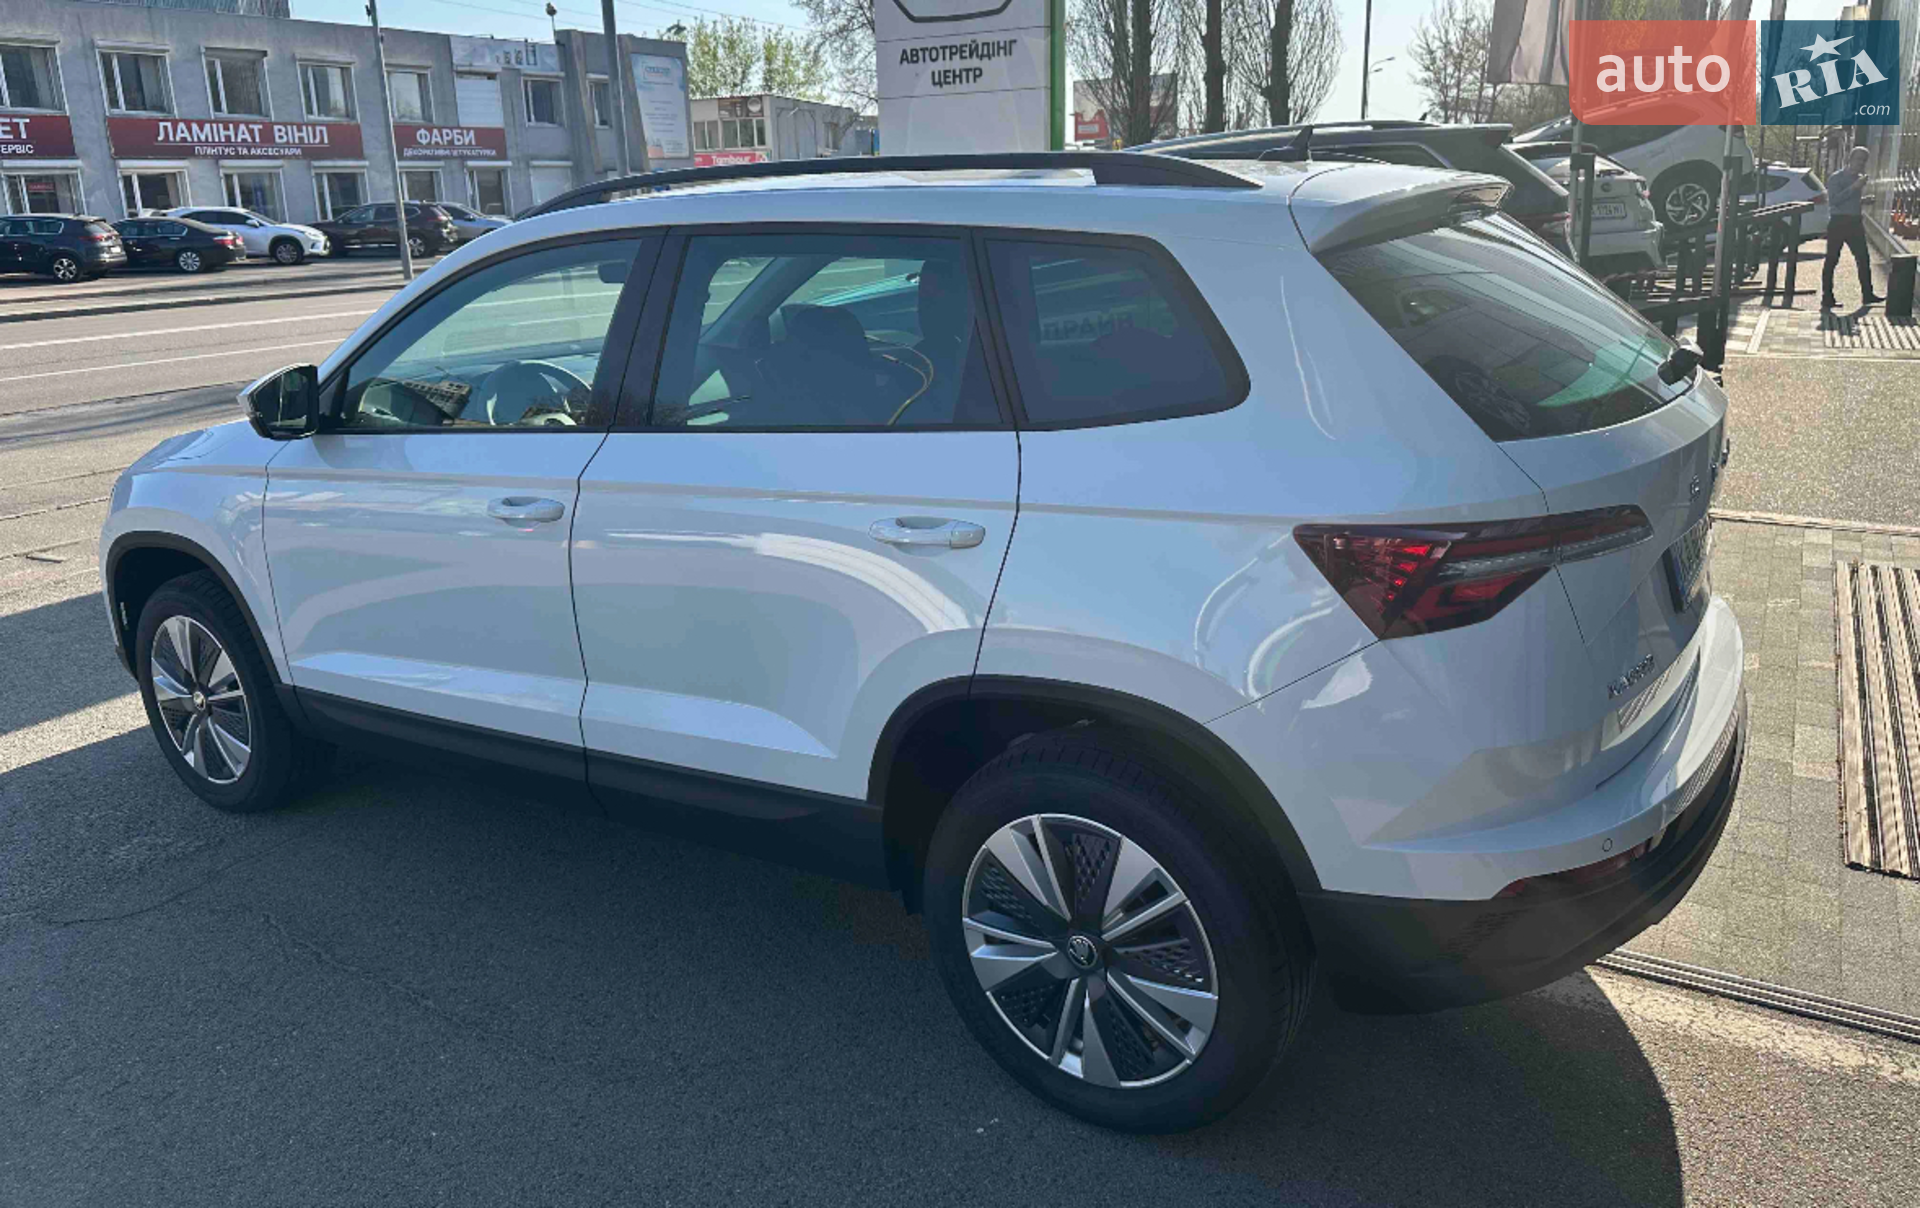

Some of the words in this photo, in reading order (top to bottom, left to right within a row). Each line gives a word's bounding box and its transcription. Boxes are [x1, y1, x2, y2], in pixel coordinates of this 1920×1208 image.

[900, 39, 1018, 65] АВТОТРЕЙДІНГ
[931, 67, 983, 88] ЦЕНТР
[157, 121, 263, 143] ЛАМІНАТ
[273, 124, 329, 144] ВІНІЛ
[416, 128, 476, 146] ФАРБИ
[0, 144, 35, 154] ЕРВІС
[237, 146, 249, 155] ТА
